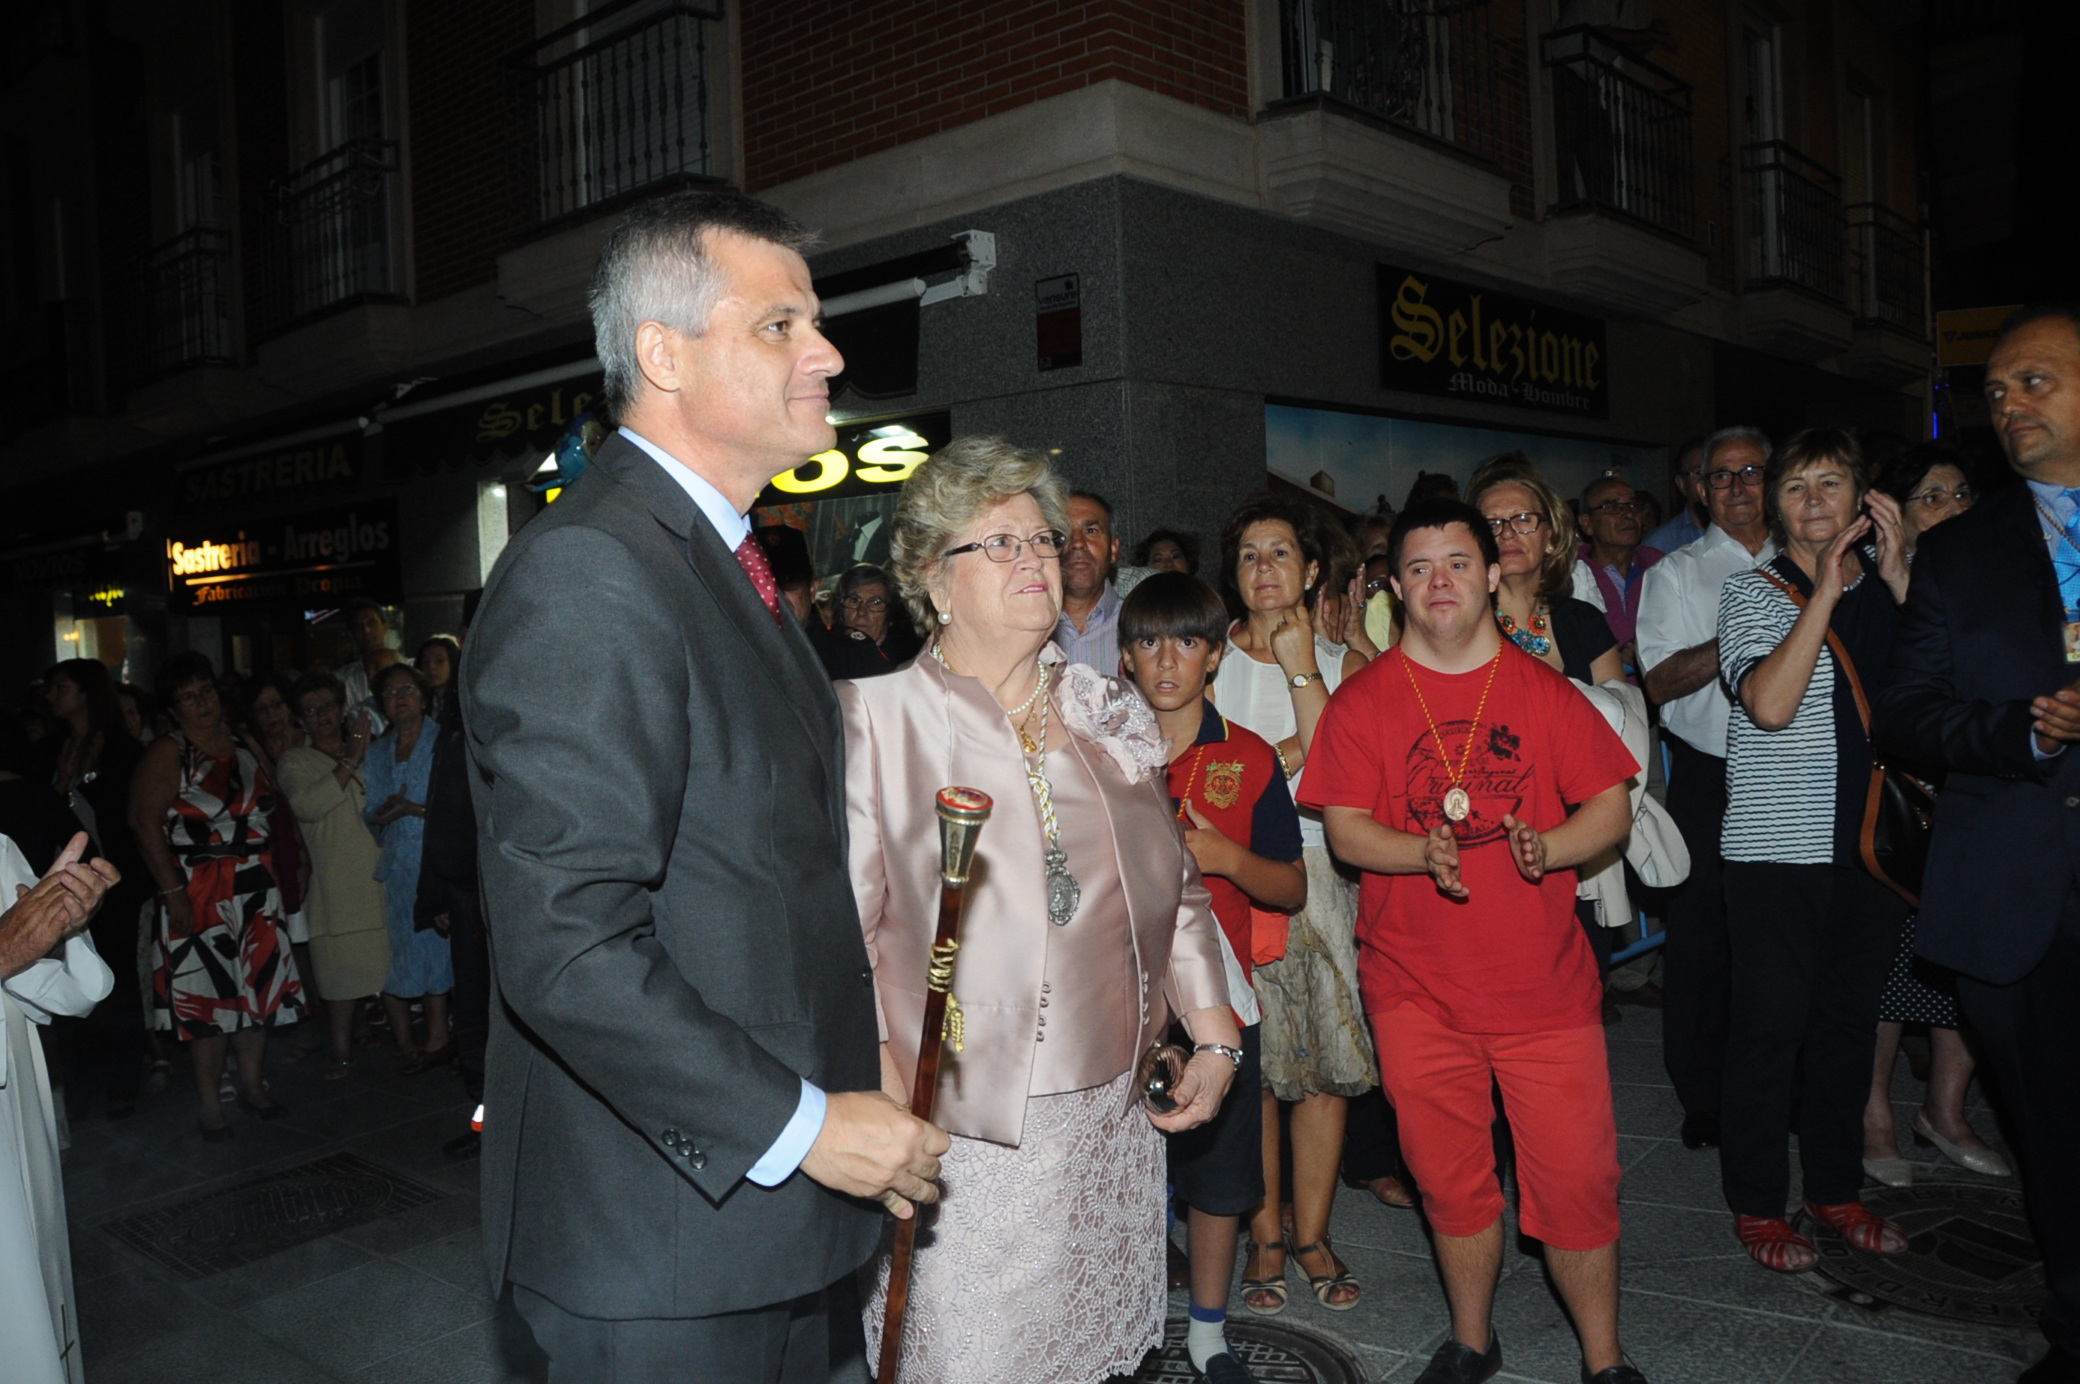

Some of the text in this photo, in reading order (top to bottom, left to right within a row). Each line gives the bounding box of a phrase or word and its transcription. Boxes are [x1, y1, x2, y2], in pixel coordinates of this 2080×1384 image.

[1389, 274, 1600, 392] Selezione
[1448, 372, 1591, 410] Moda Hombre
[183, 443, 353, 504] SASTRERIA
[171, 529, 261, 576] Sastreria
[283, 512, 390, 562] Arreglos
